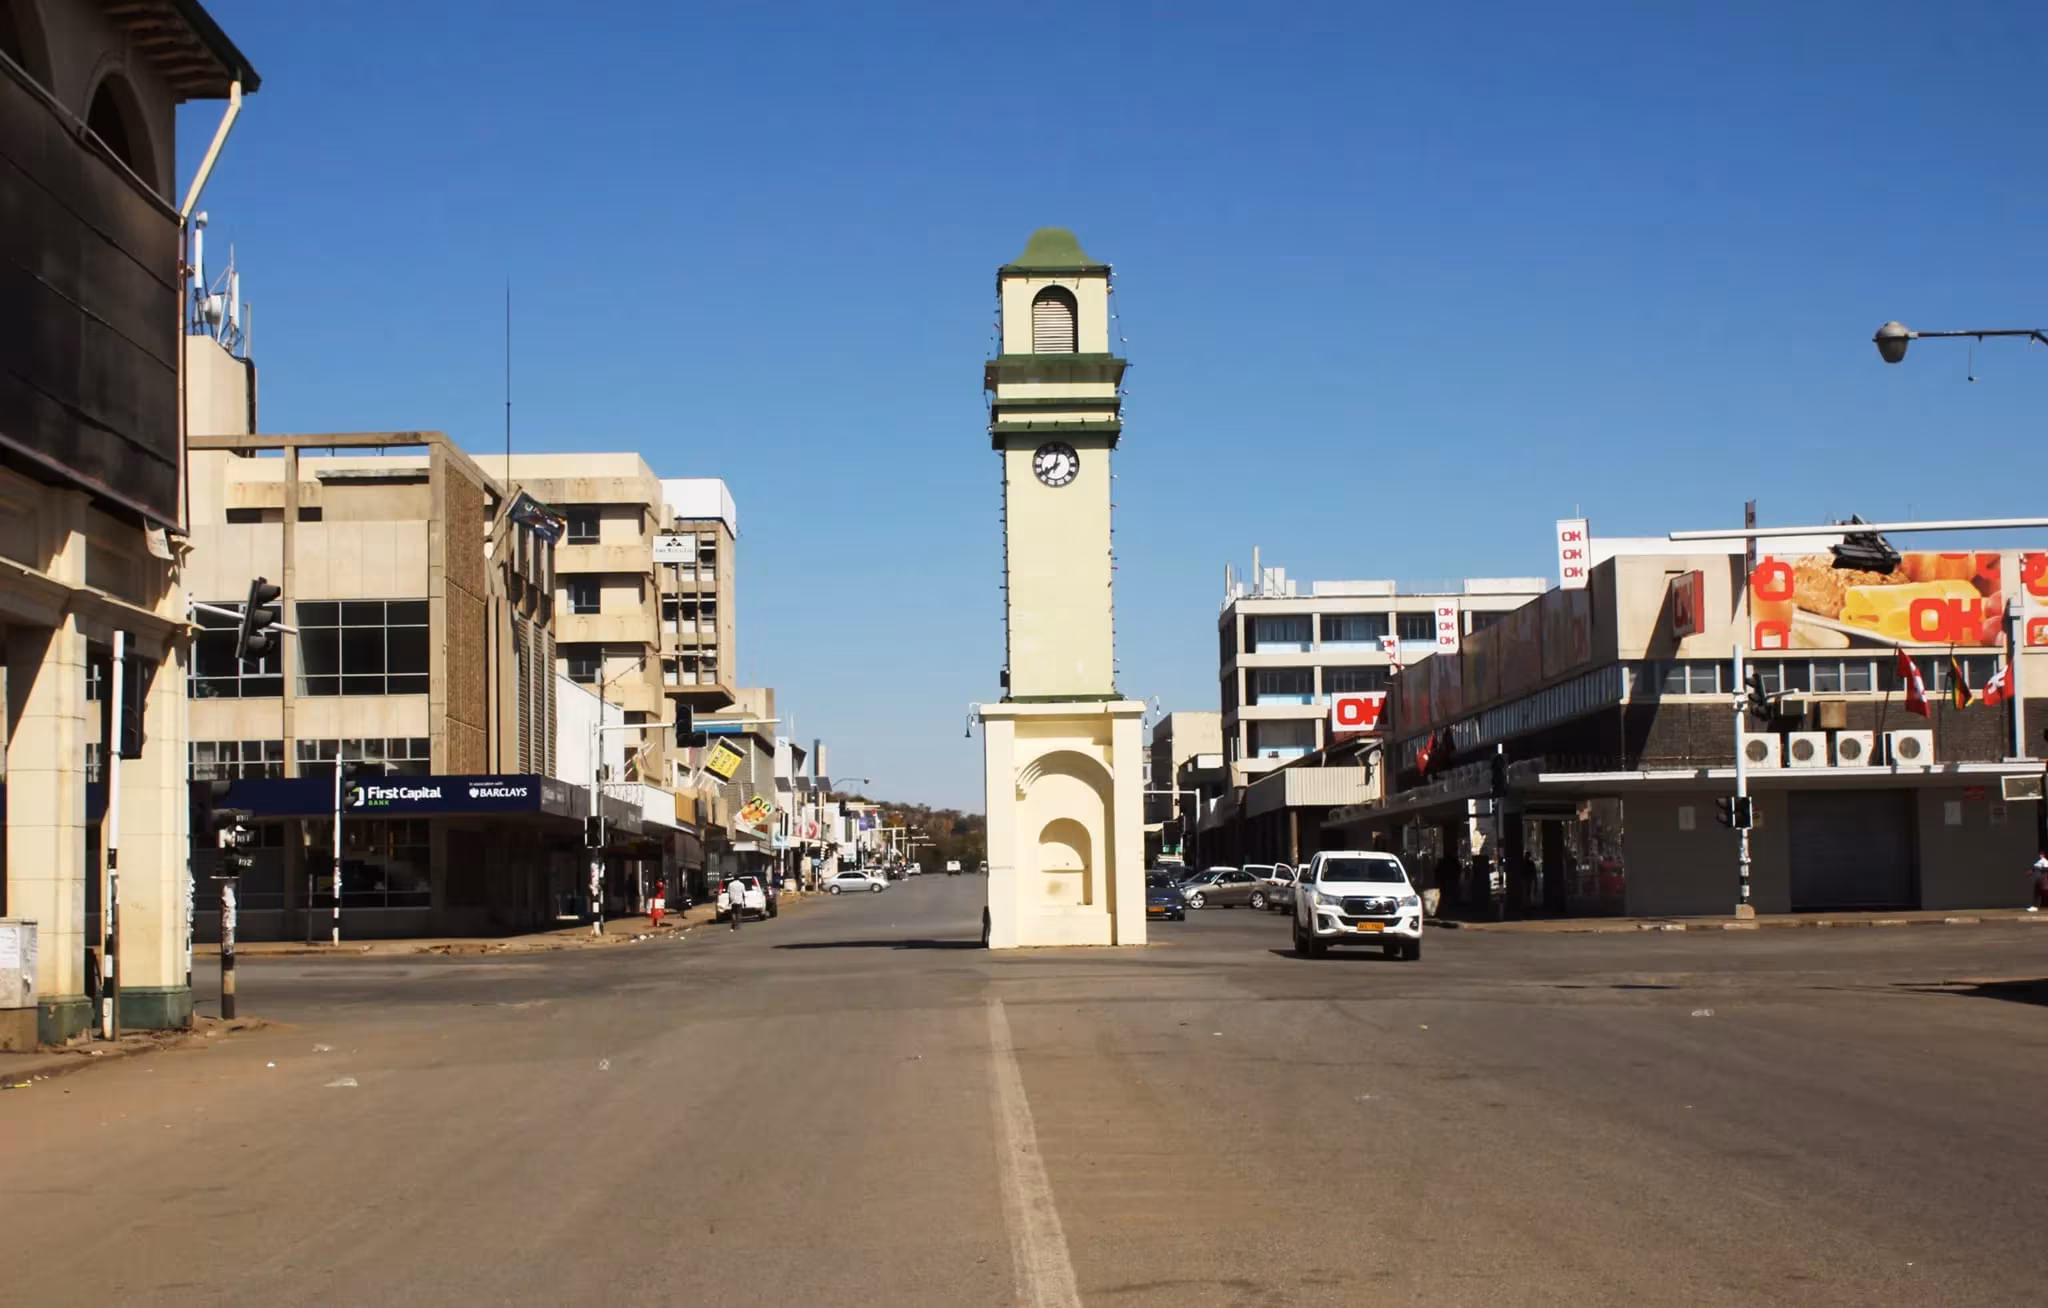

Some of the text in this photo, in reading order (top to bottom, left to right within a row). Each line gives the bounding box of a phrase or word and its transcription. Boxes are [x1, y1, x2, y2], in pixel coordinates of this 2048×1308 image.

[1561, 531, 1582, 542] OK
[1563, 549, 1582, 560] OK
[1564, 567, 1583, 578] OK
[1438, 608, 1453, 617] OK
[1909, 598, 1984, 641] OK
[1439, 622, 1455, 631] OK
[1440, 636, 1455, 645] OK
[1337, 697, 1388, 725] OK
[367, 786, 442, 802] First Capital
[479, 787, 528, 798] BARCLAYS
